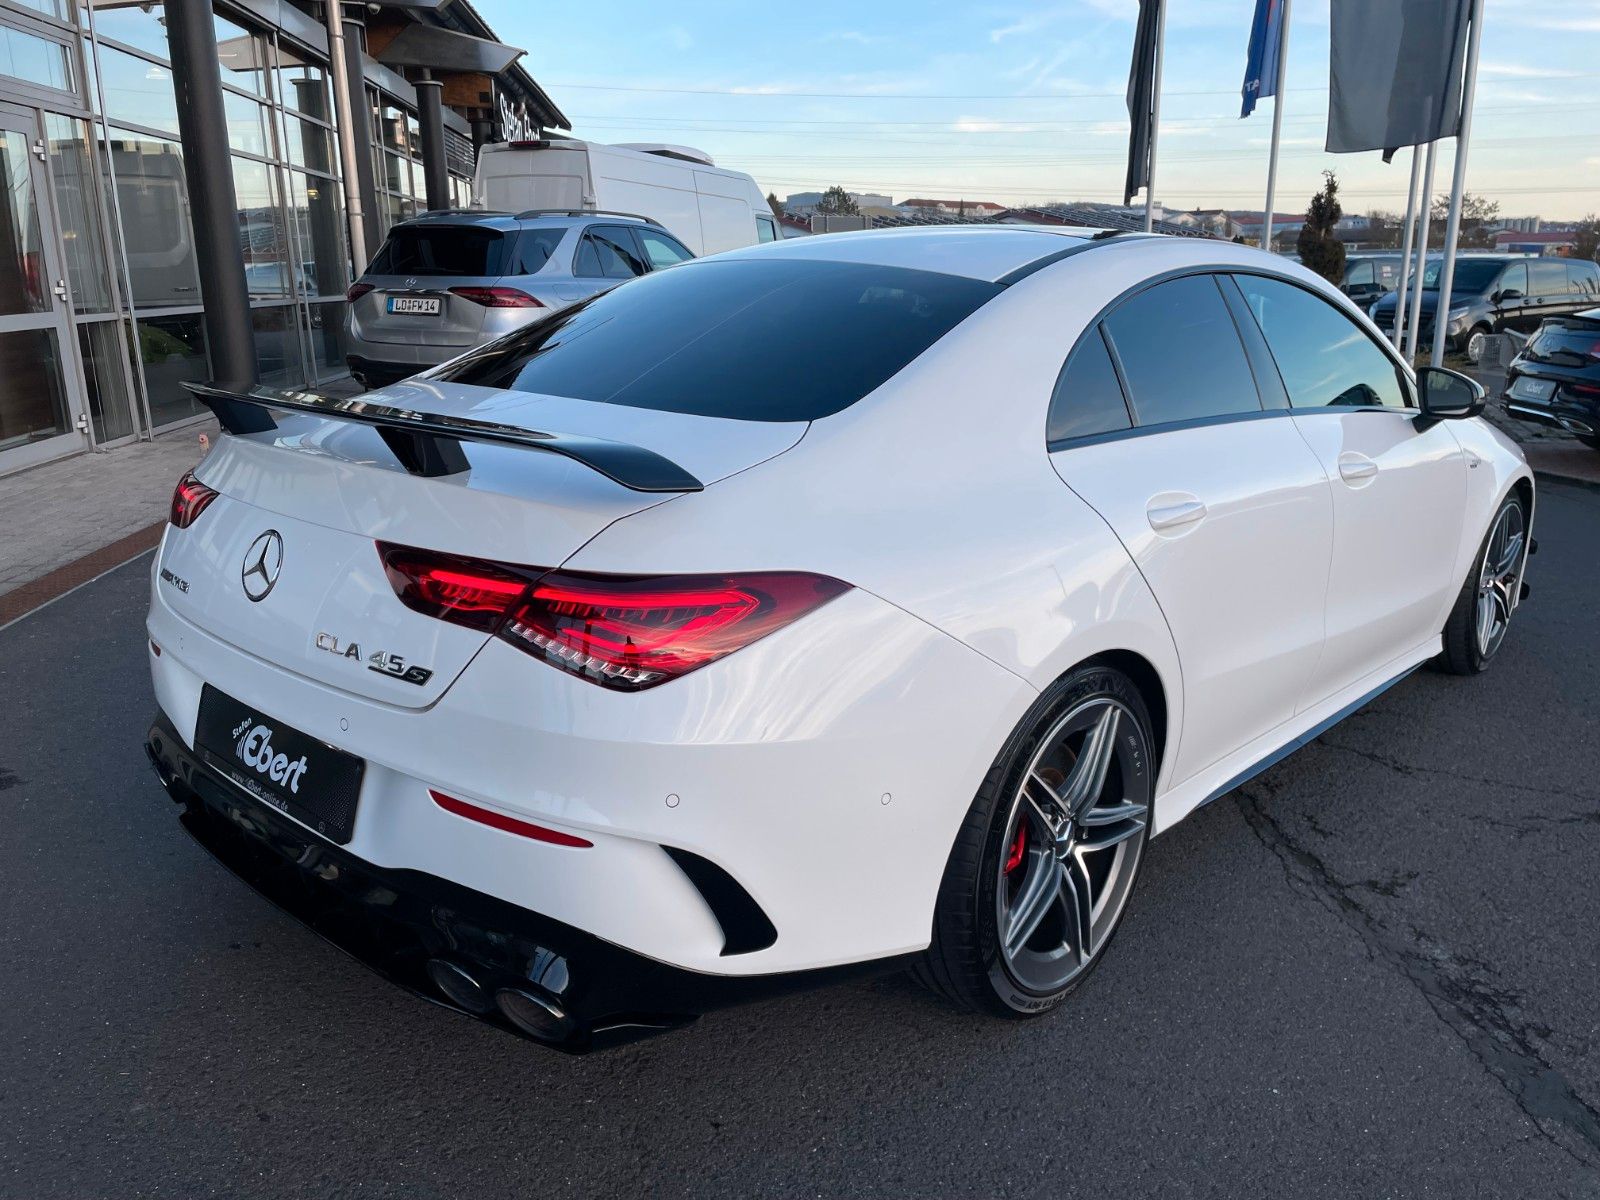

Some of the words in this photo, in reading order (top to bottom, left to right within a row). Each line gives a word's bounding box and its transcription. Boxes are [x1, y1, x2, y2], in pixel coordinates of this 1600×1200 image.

[425, 301, 436, 311] 14
[316, 632, 362, 662] CLA
[232, 717, 252, 739] Stefan
[242, 724, 308, 794] Ebert
